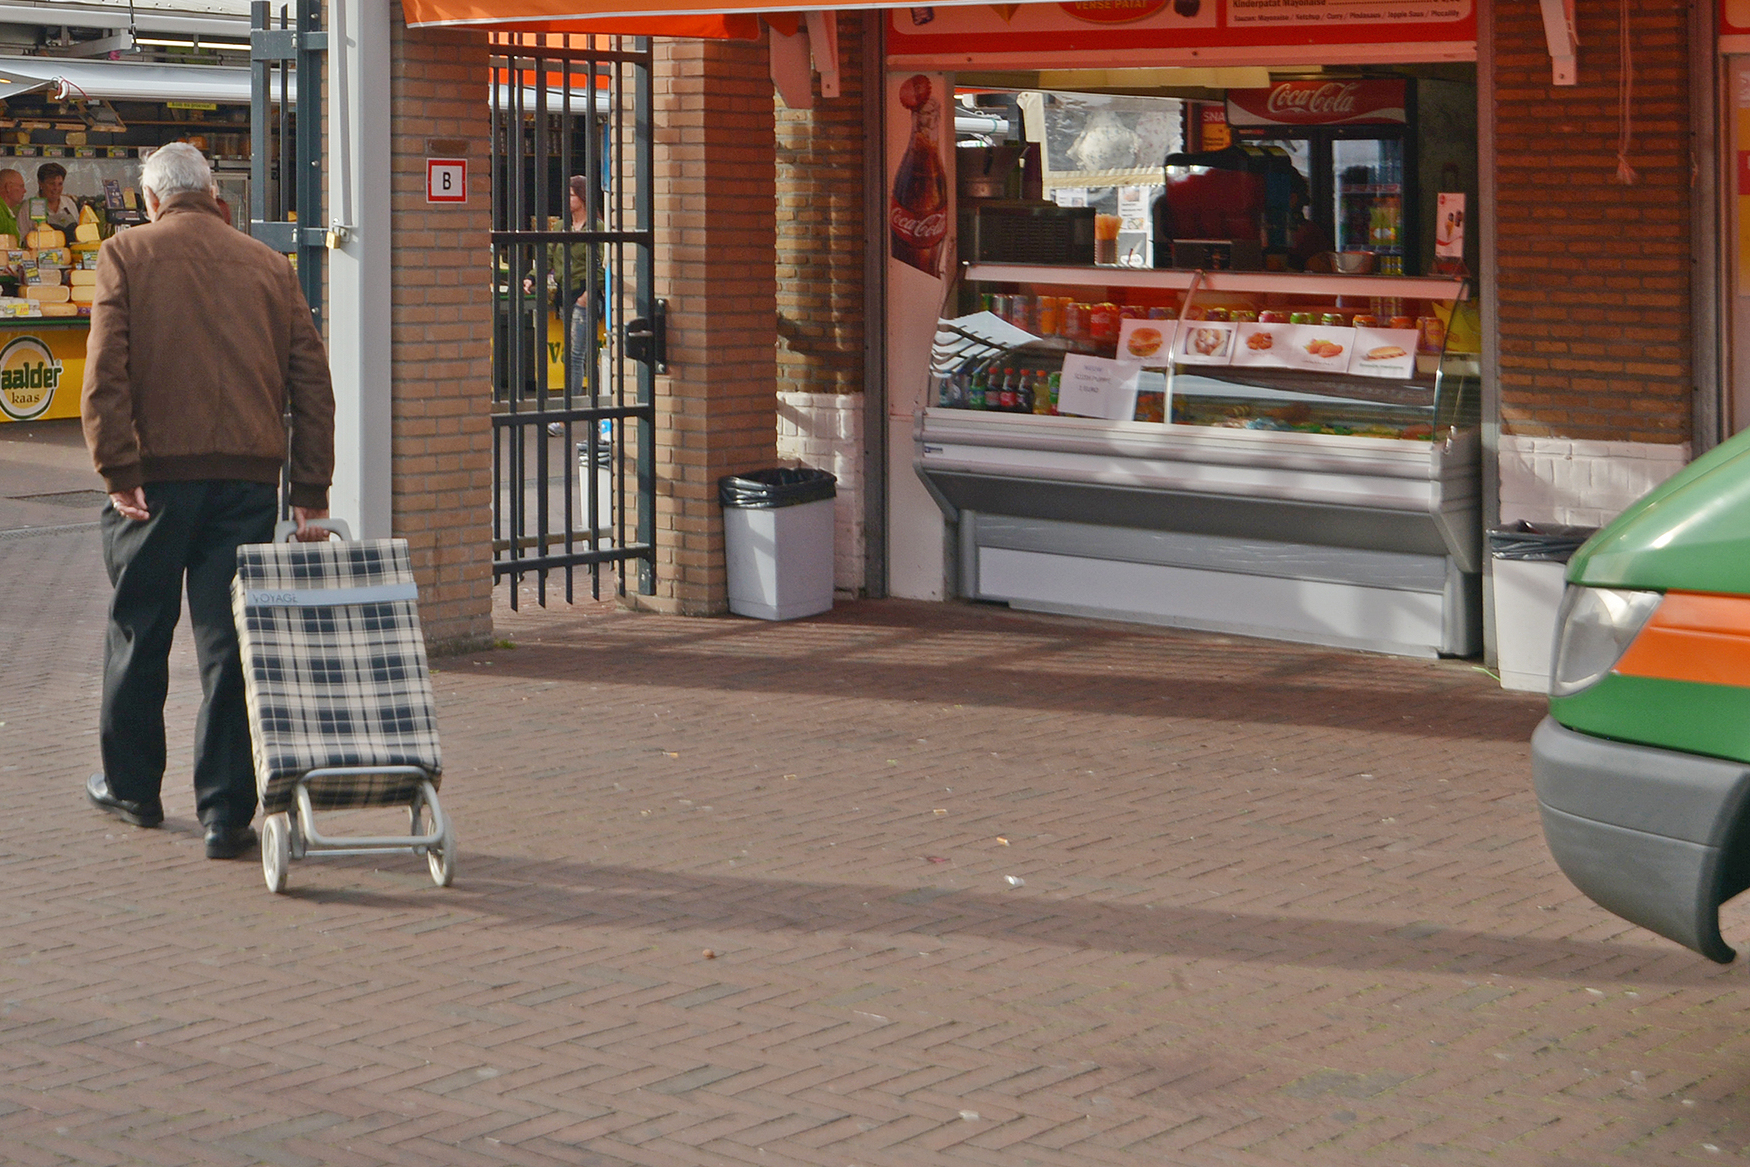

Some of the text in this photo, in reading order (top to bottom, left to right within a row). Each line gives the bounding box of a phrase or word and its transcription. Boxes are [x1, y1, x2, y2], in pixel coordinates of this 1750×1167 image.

[442, 171, 452, 190] B
[11, 392, 40, 404] kaas
[252, 593, 298, 603] VOYAGE
